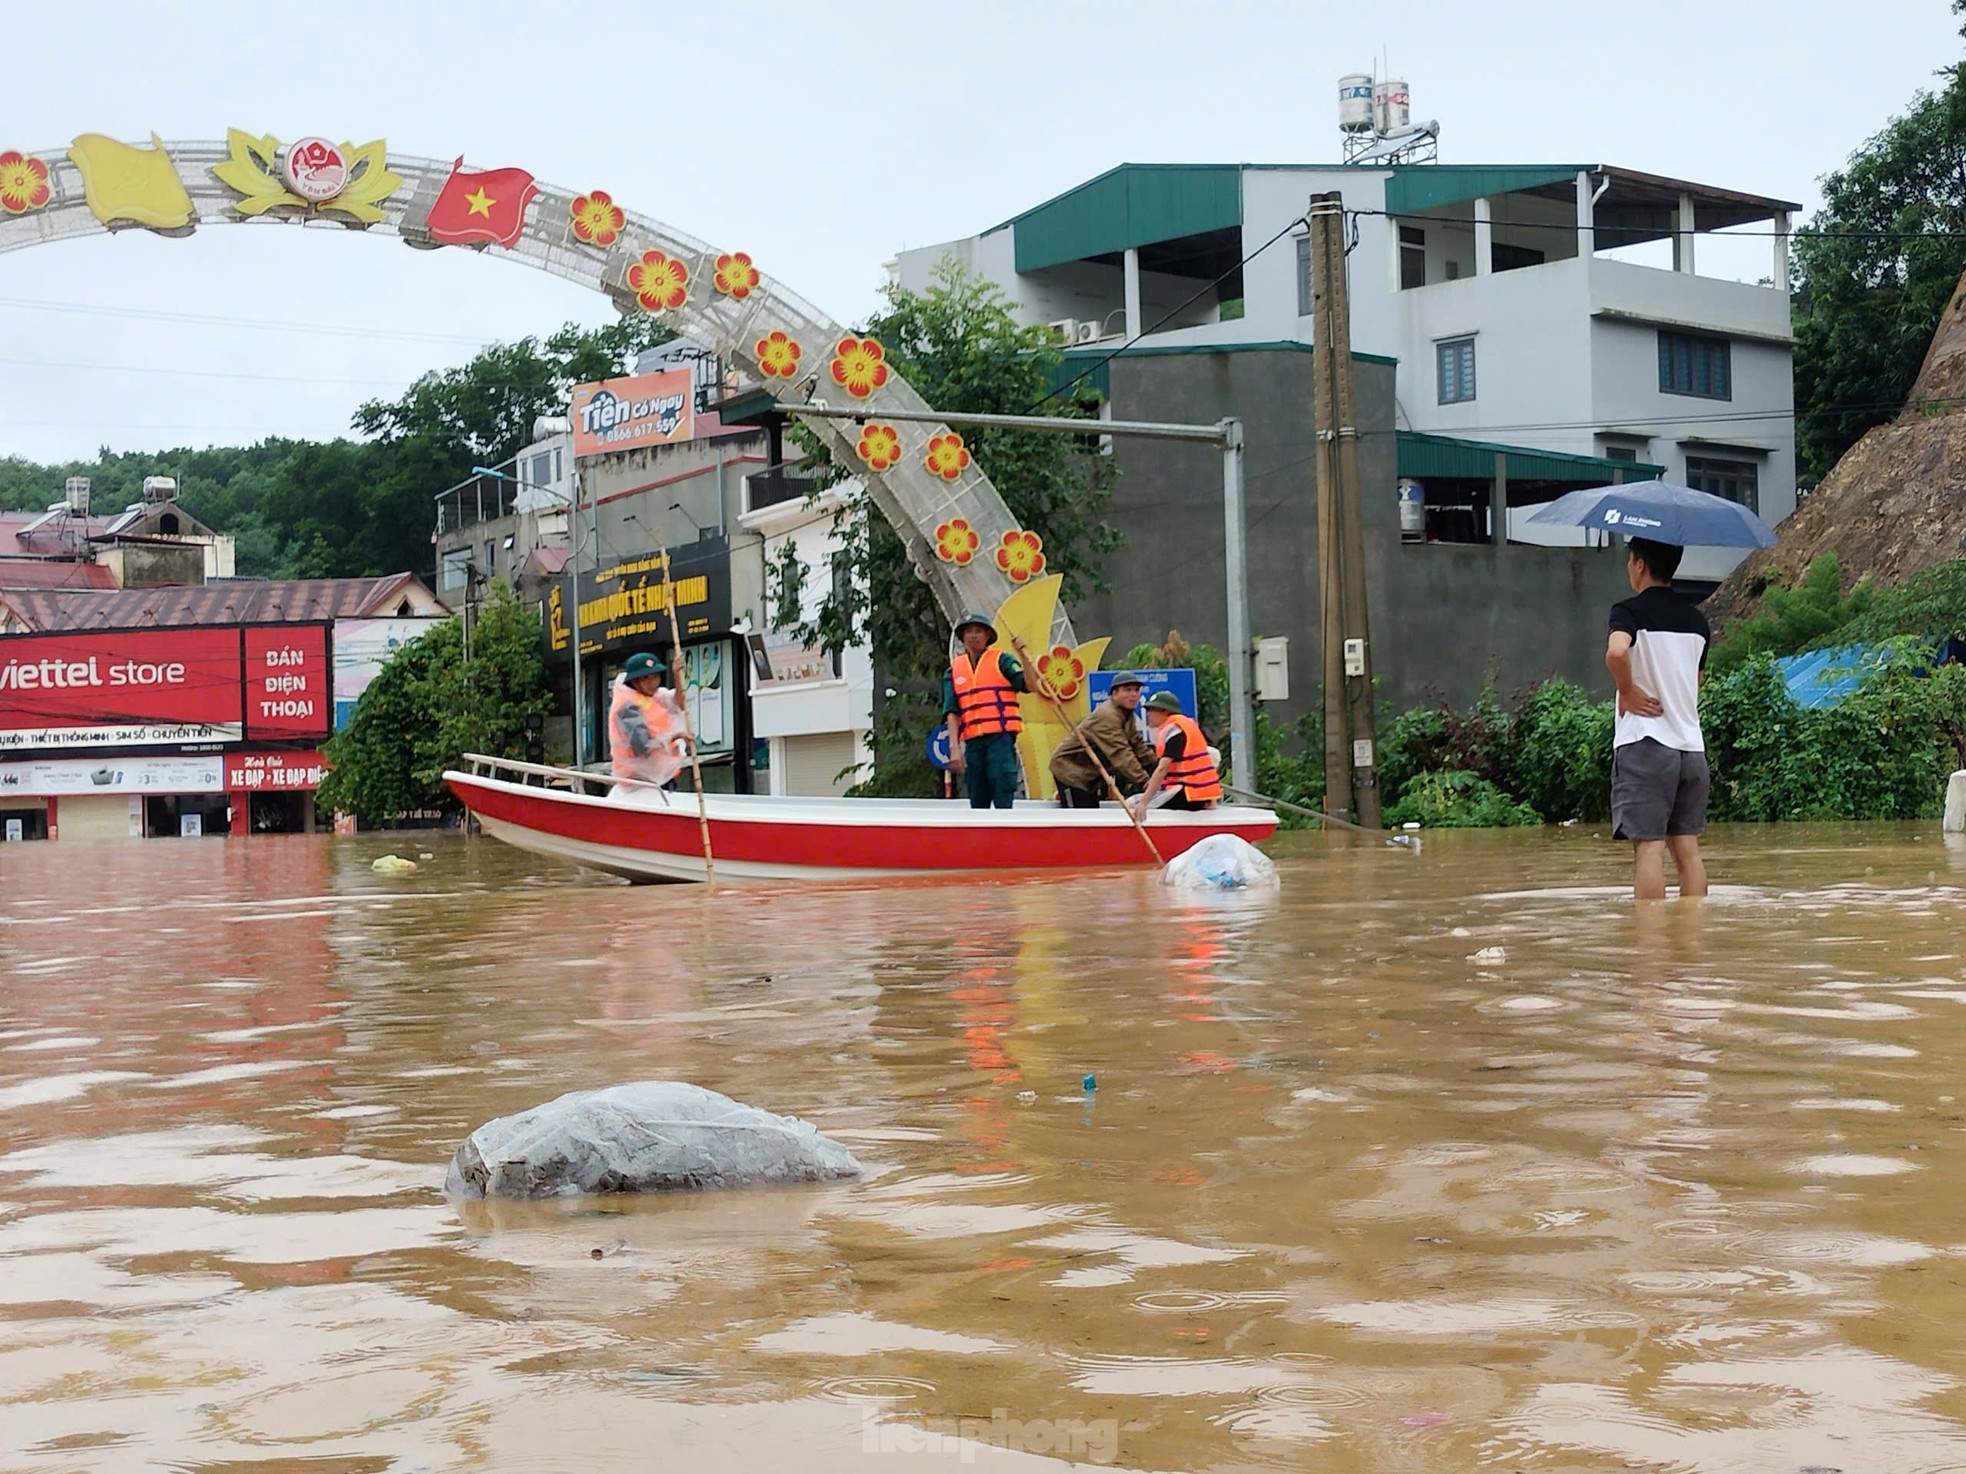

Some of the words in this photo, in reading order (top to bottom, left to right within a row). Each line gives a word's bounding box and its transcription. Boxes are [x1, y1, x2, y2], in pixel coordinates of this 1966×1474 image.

[580, 393, 631, 434] Tiền
[266, 645, 304, 667] BÁN
[0, 656, 103, 690] viettel
[109, 659, 185, 686] store
[265, 672, 306, 696] ĐIỆN
[260, 700, 313, 719] THOẠI
[231, 769, 244, 787] XE
[272, 768, 286, 786] XE
